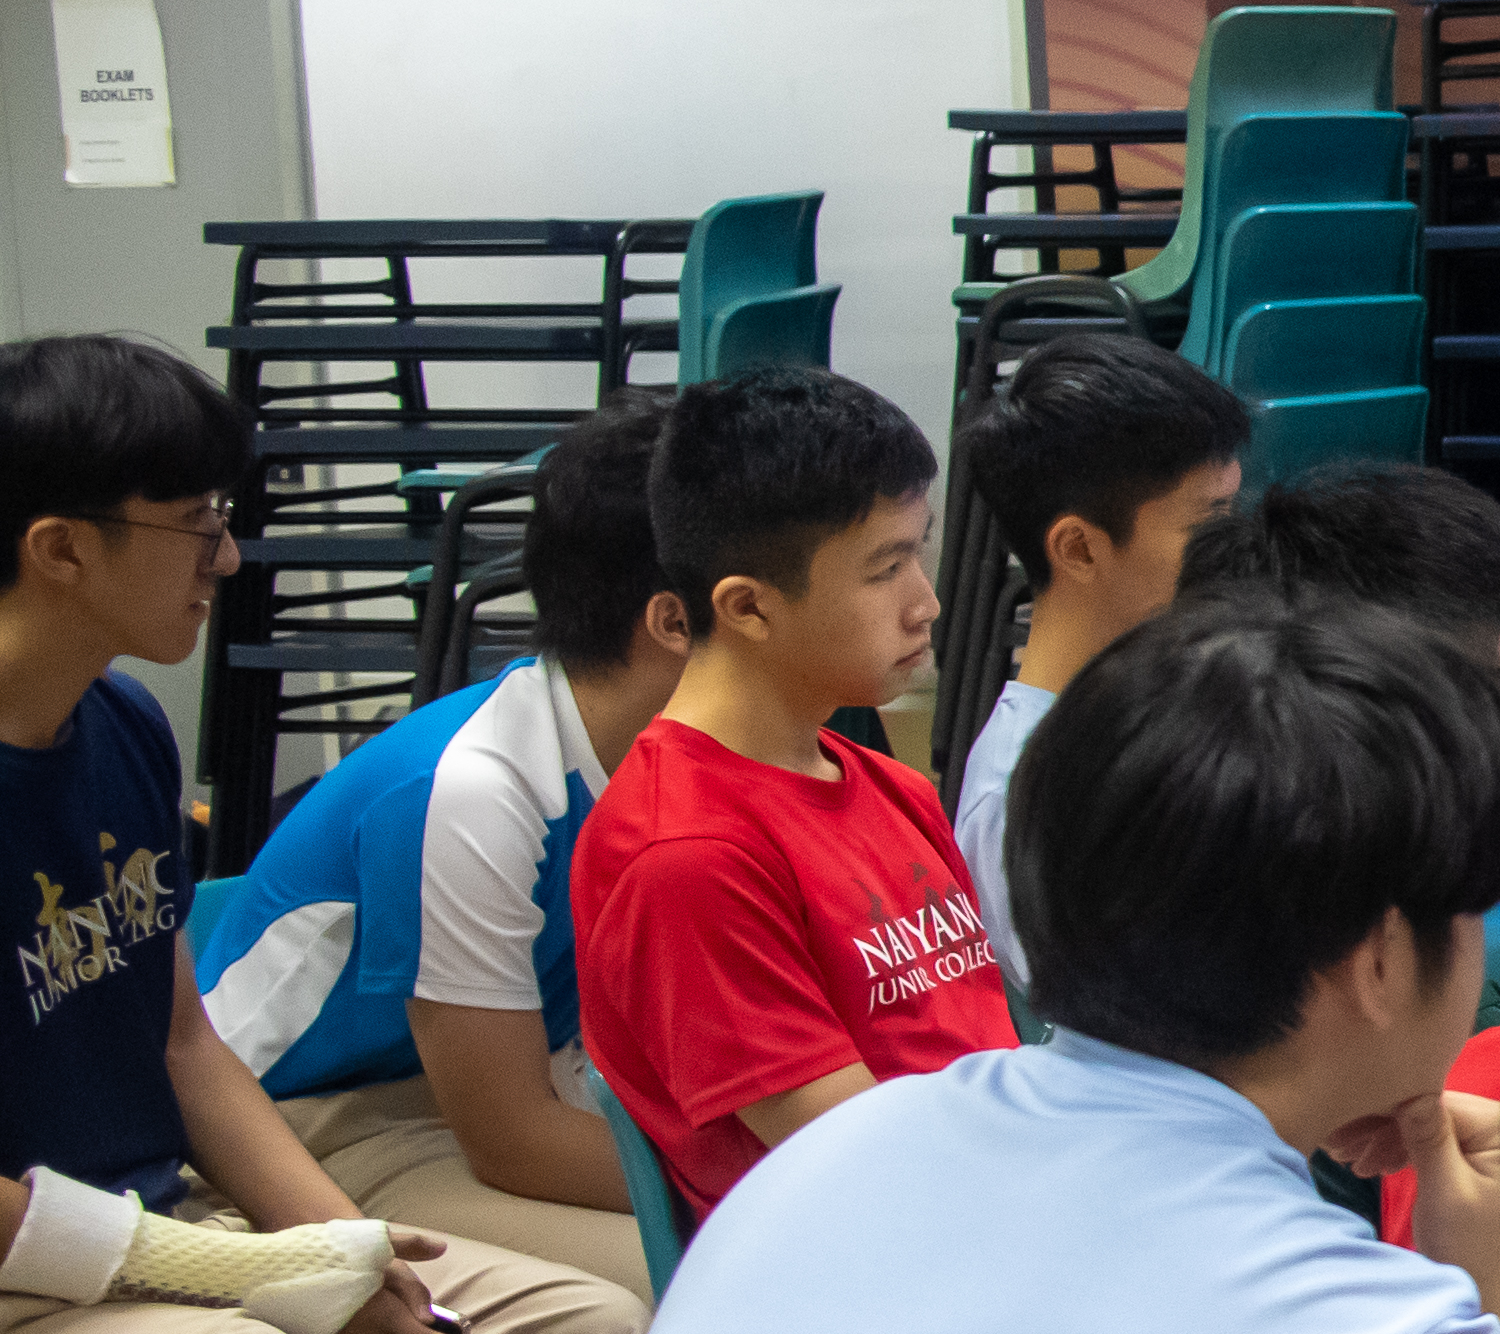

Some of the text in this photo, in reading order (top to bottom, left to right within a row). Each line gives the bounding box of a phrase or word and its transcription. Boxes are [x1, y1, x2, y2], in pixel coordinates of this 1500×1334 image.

[96, 69, 135, 83] EXAM
[80, 88, 154, 103] BOOKLETS
[853, 892, 985, 979] NAYAN
[868, 966, 938, 1016] JUNIR
